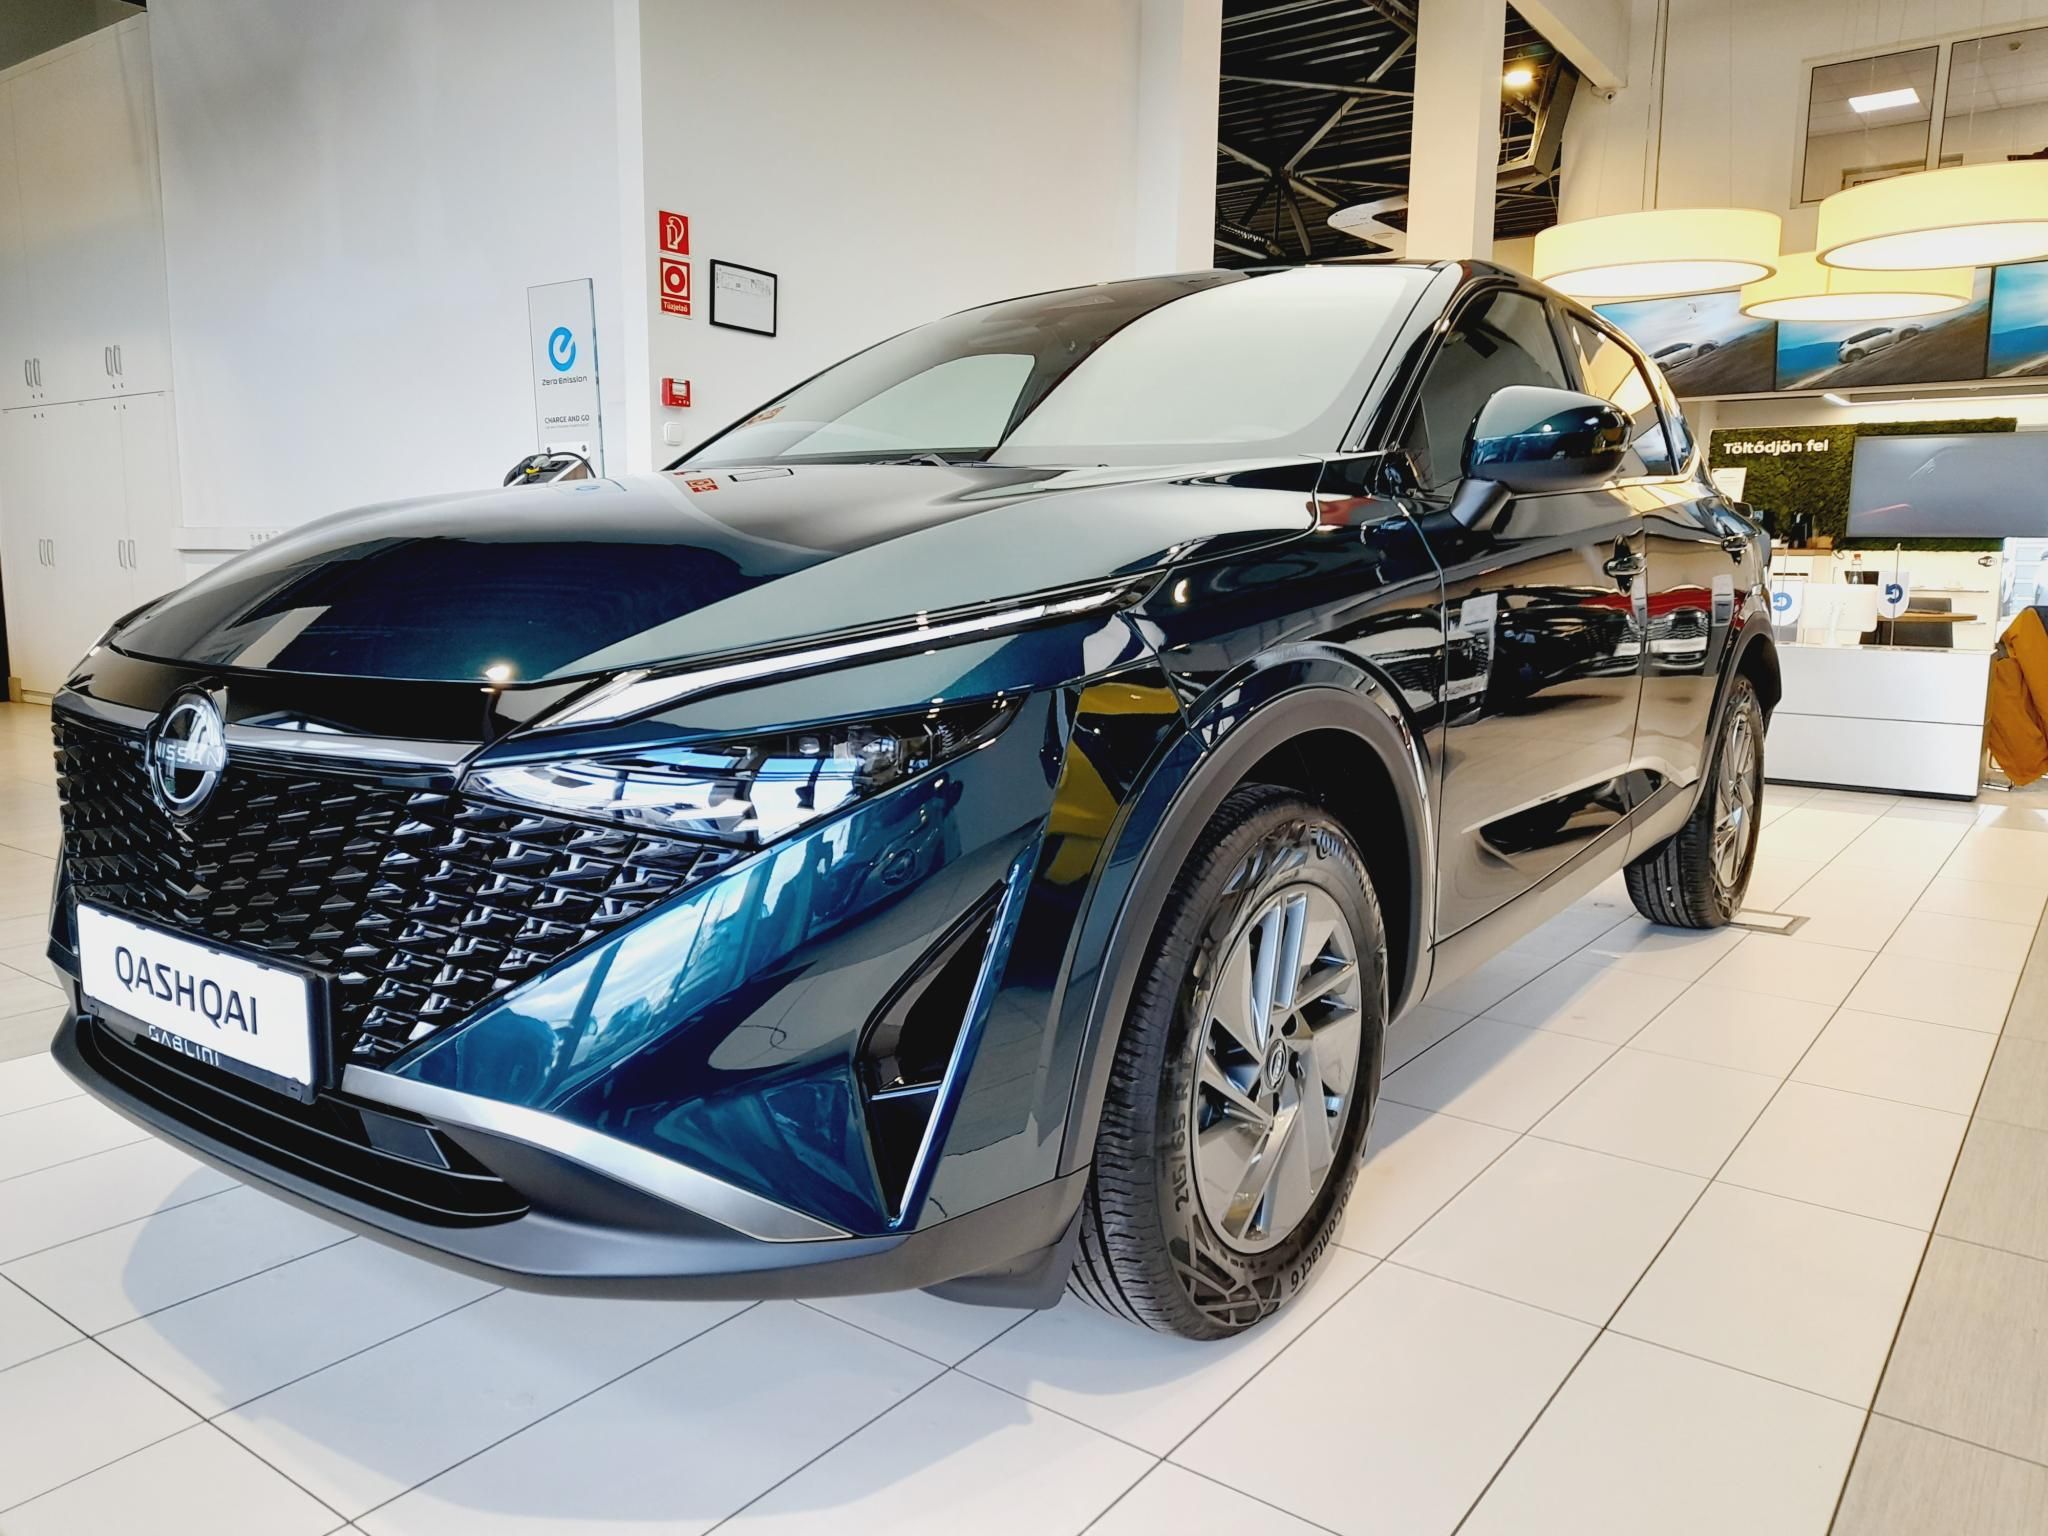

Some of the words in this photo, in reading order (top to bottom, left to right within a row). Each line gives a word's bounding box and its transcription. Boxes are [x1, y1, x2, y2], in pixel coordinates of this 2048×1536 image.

[541, 378, 558, 386] Zero
[558, 375, 588, 385] Emission
[544, 415, 567, 424] CHARGE
[567, 414, 580, 423] AND
[580, 414, 590, 422] GO
[1723, 440, 1803, 457] Töltődjön
[1805, 438, 1829, 453] fel
[156, 740, 224, 768] NISSAN
[114, 945, 258, 1036] QASHQAI
[148, 1024, 220, 1067] GABLINI
